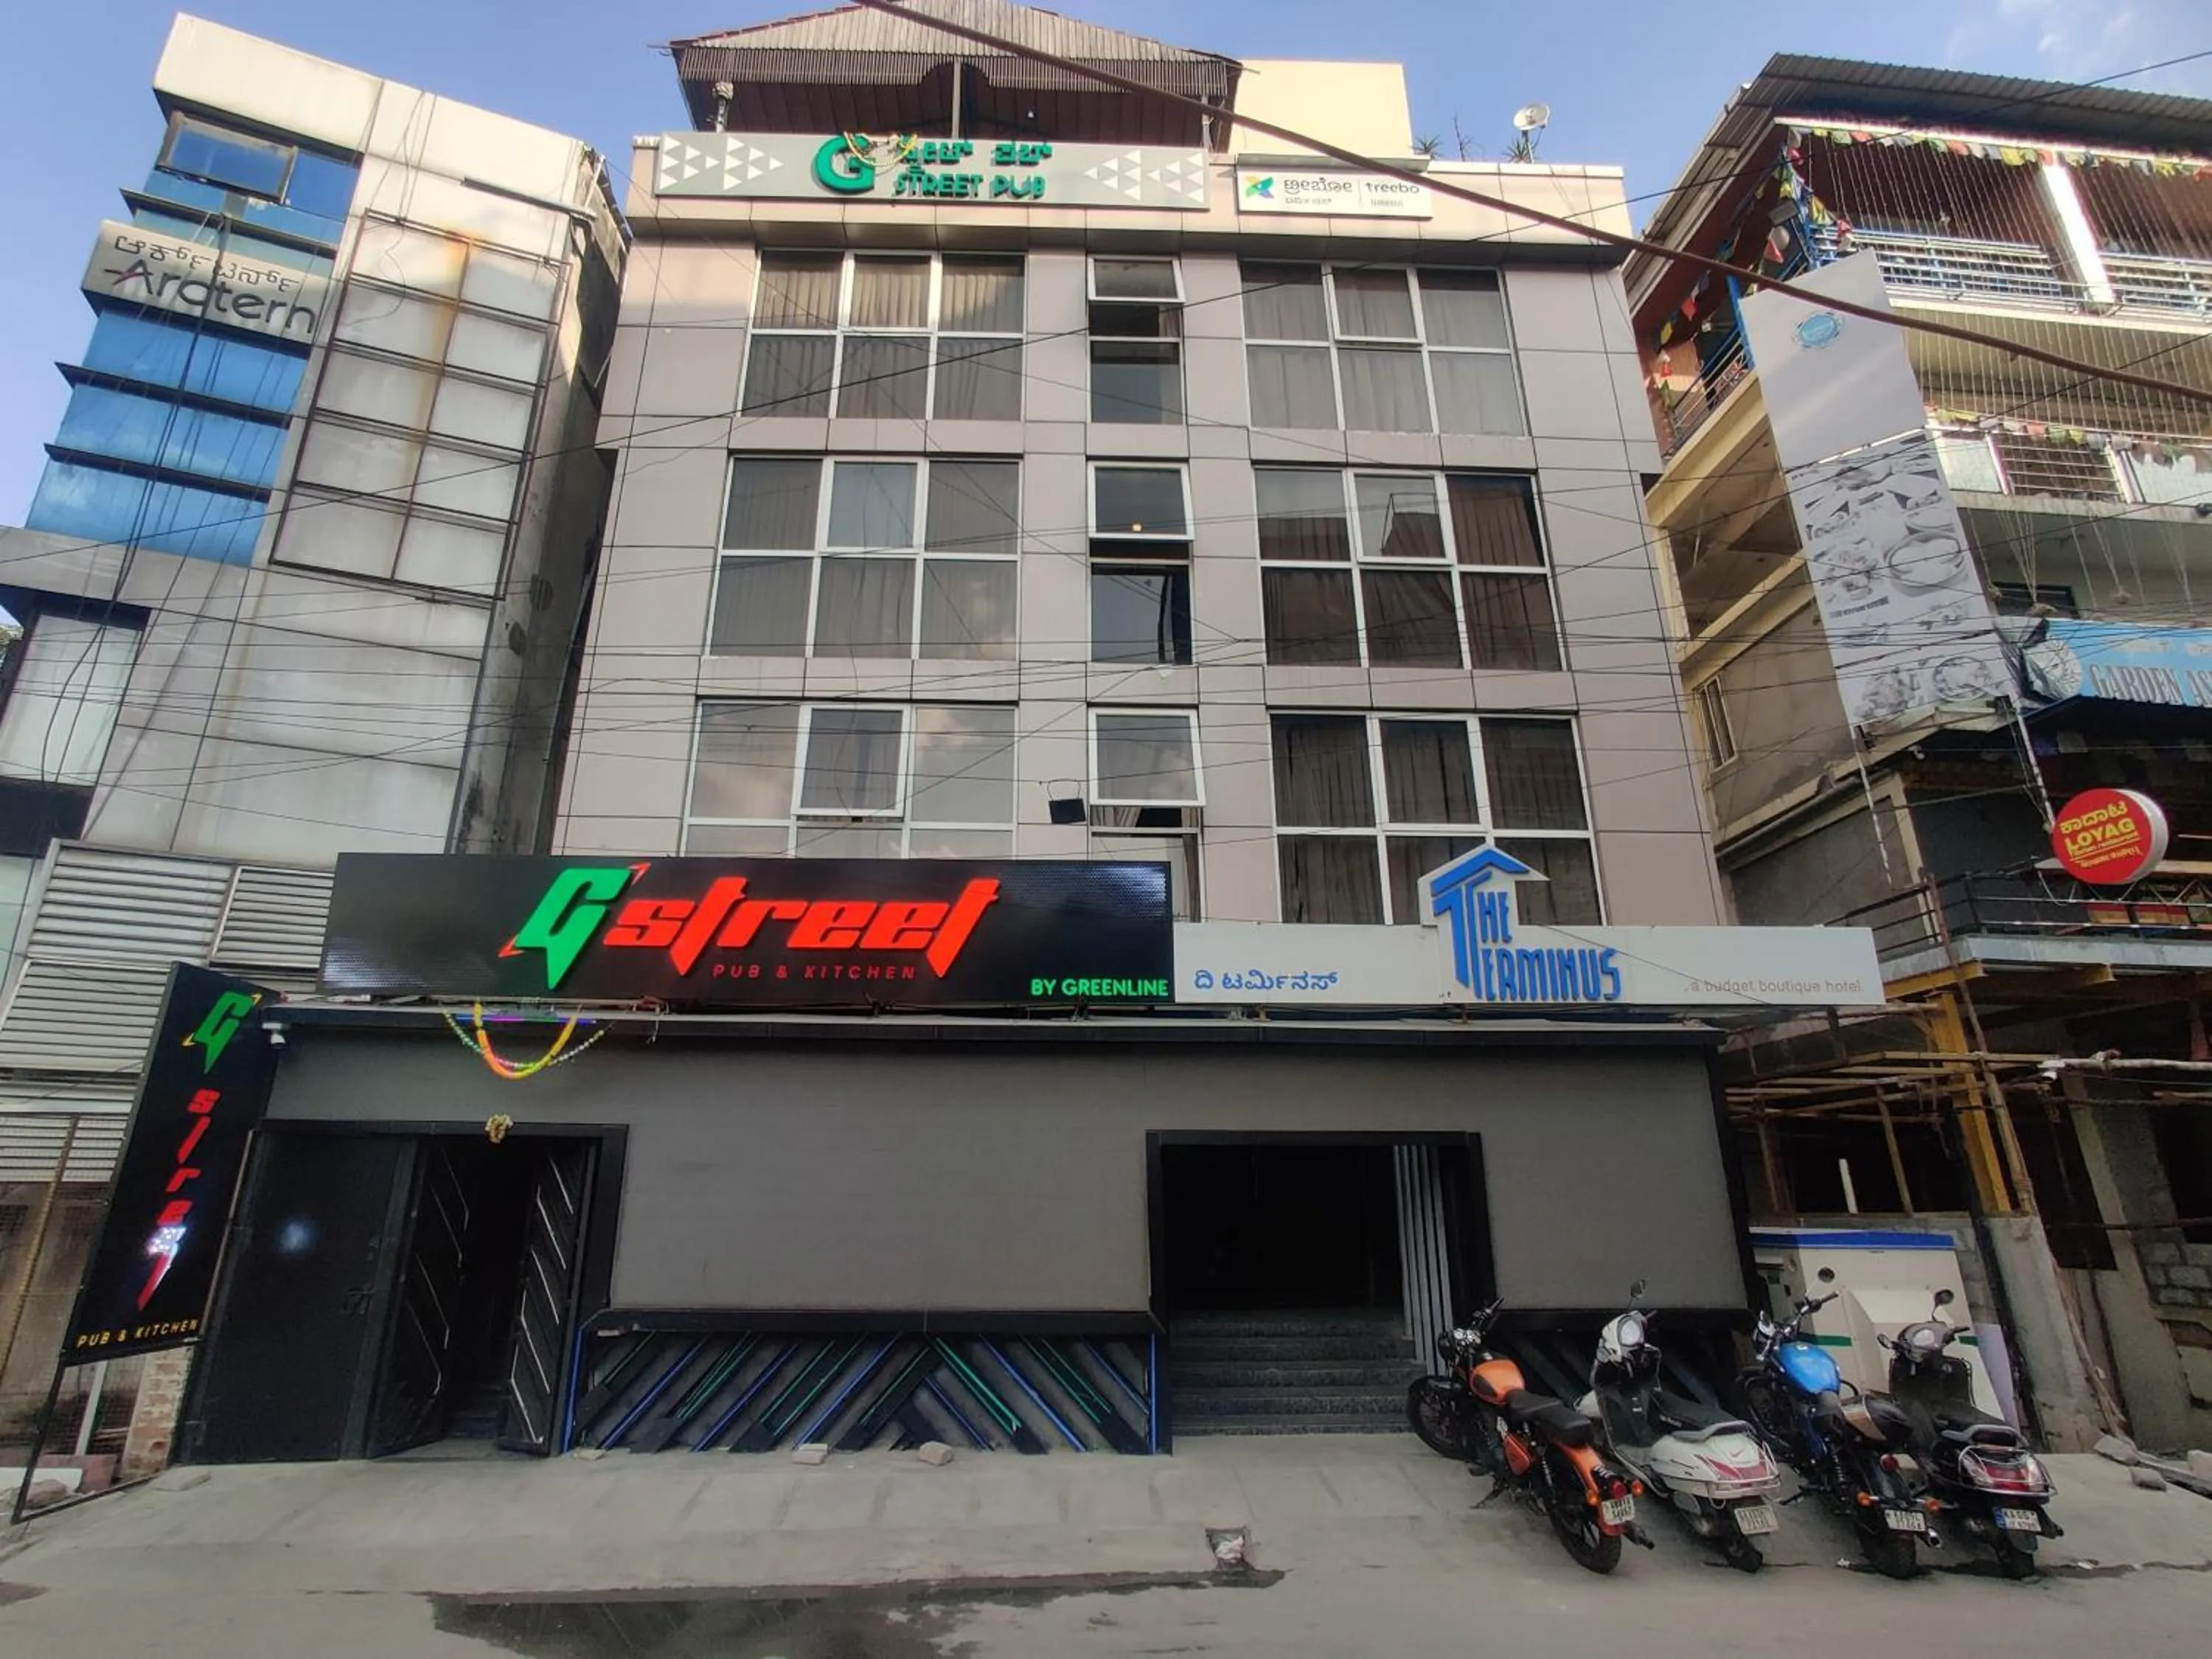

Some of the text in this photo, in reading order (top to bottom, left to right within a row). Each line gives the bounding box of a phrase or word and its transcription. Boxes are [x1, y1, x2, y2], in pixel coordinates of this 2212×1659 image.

[814, 134, 876, 192] G
[894, 173, 1046, 199] STREET PUB
[1366, 181, 1420, 194] treebo
[2090, 664, 2184, 706] GARDEN
[712, 964, 915, 979] PUB & KITCHEN
[1194, 968, 1338, 990] ದಿ ಟರ್ಮಿನಸ್
[1032, 978, 1169, 996] BY GREENLINE
[1705, 979, 1753, 995] budget
[1759, 979, 1820, 995] boutique
[192, 991, 254, 1074] G
[77, 1318, 199, 1348] PUB & KITCHEN
